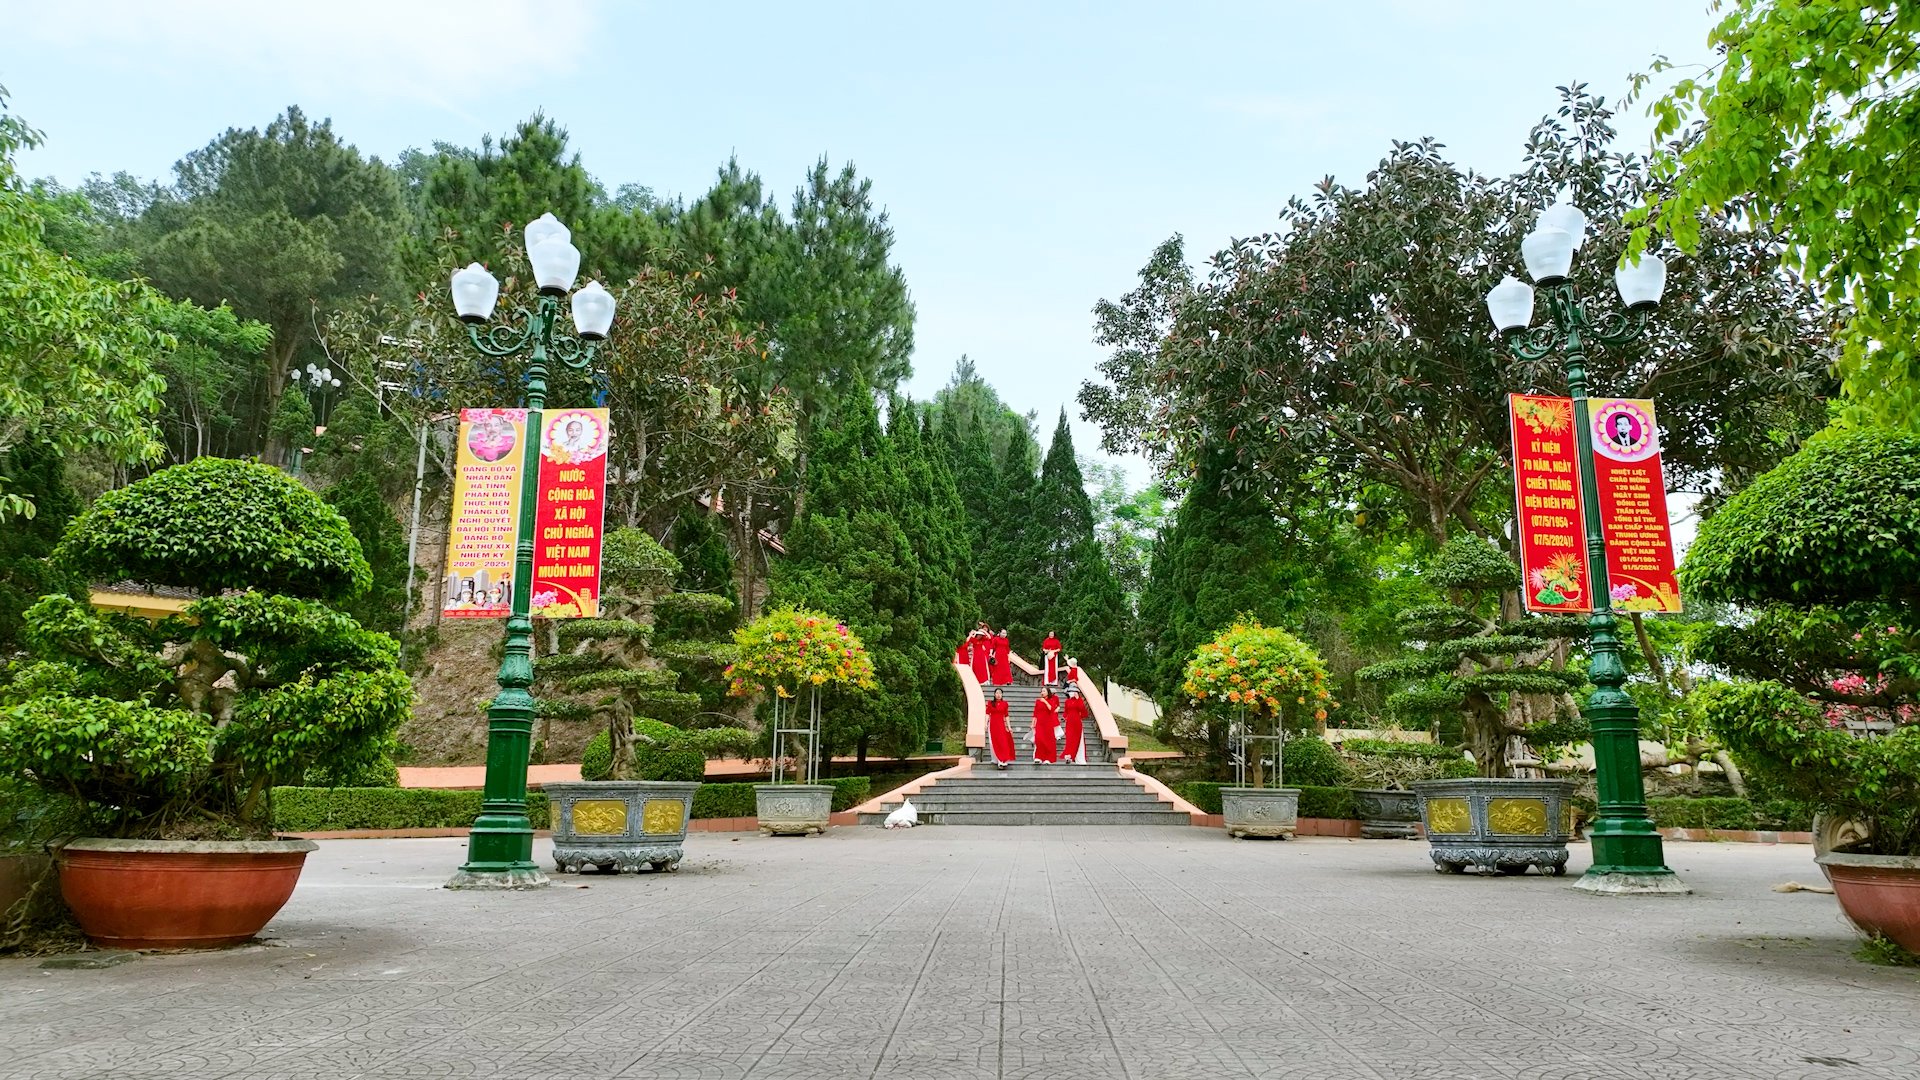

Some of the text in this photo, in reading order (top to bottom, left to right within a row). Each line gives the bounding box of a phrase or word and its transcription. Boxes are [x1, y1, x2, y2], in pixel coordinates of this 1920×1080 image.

[1531, 438, 1560, 456] KỶ NIỆM
[1522, 458, 1571, 473] 70 NĂM, NGÀY
[560, 468, 585, 482] NƯỚC
[1526, 475, 1572, 491] CHIẾN THẮNG
[548, 486, 595, 503] CỘNG HÒA
[1525, 494, 1576, 510] ĐIỆN BIÊN PHỦ
[554, 506, 586, 522] XÃ HỘI
[544, 524, 594, 539] CHỦ NGHĨA
[546, 544, 590, 560] VIỆT NAM
[538, 563, 594, 577] MUÔN NĂM!
